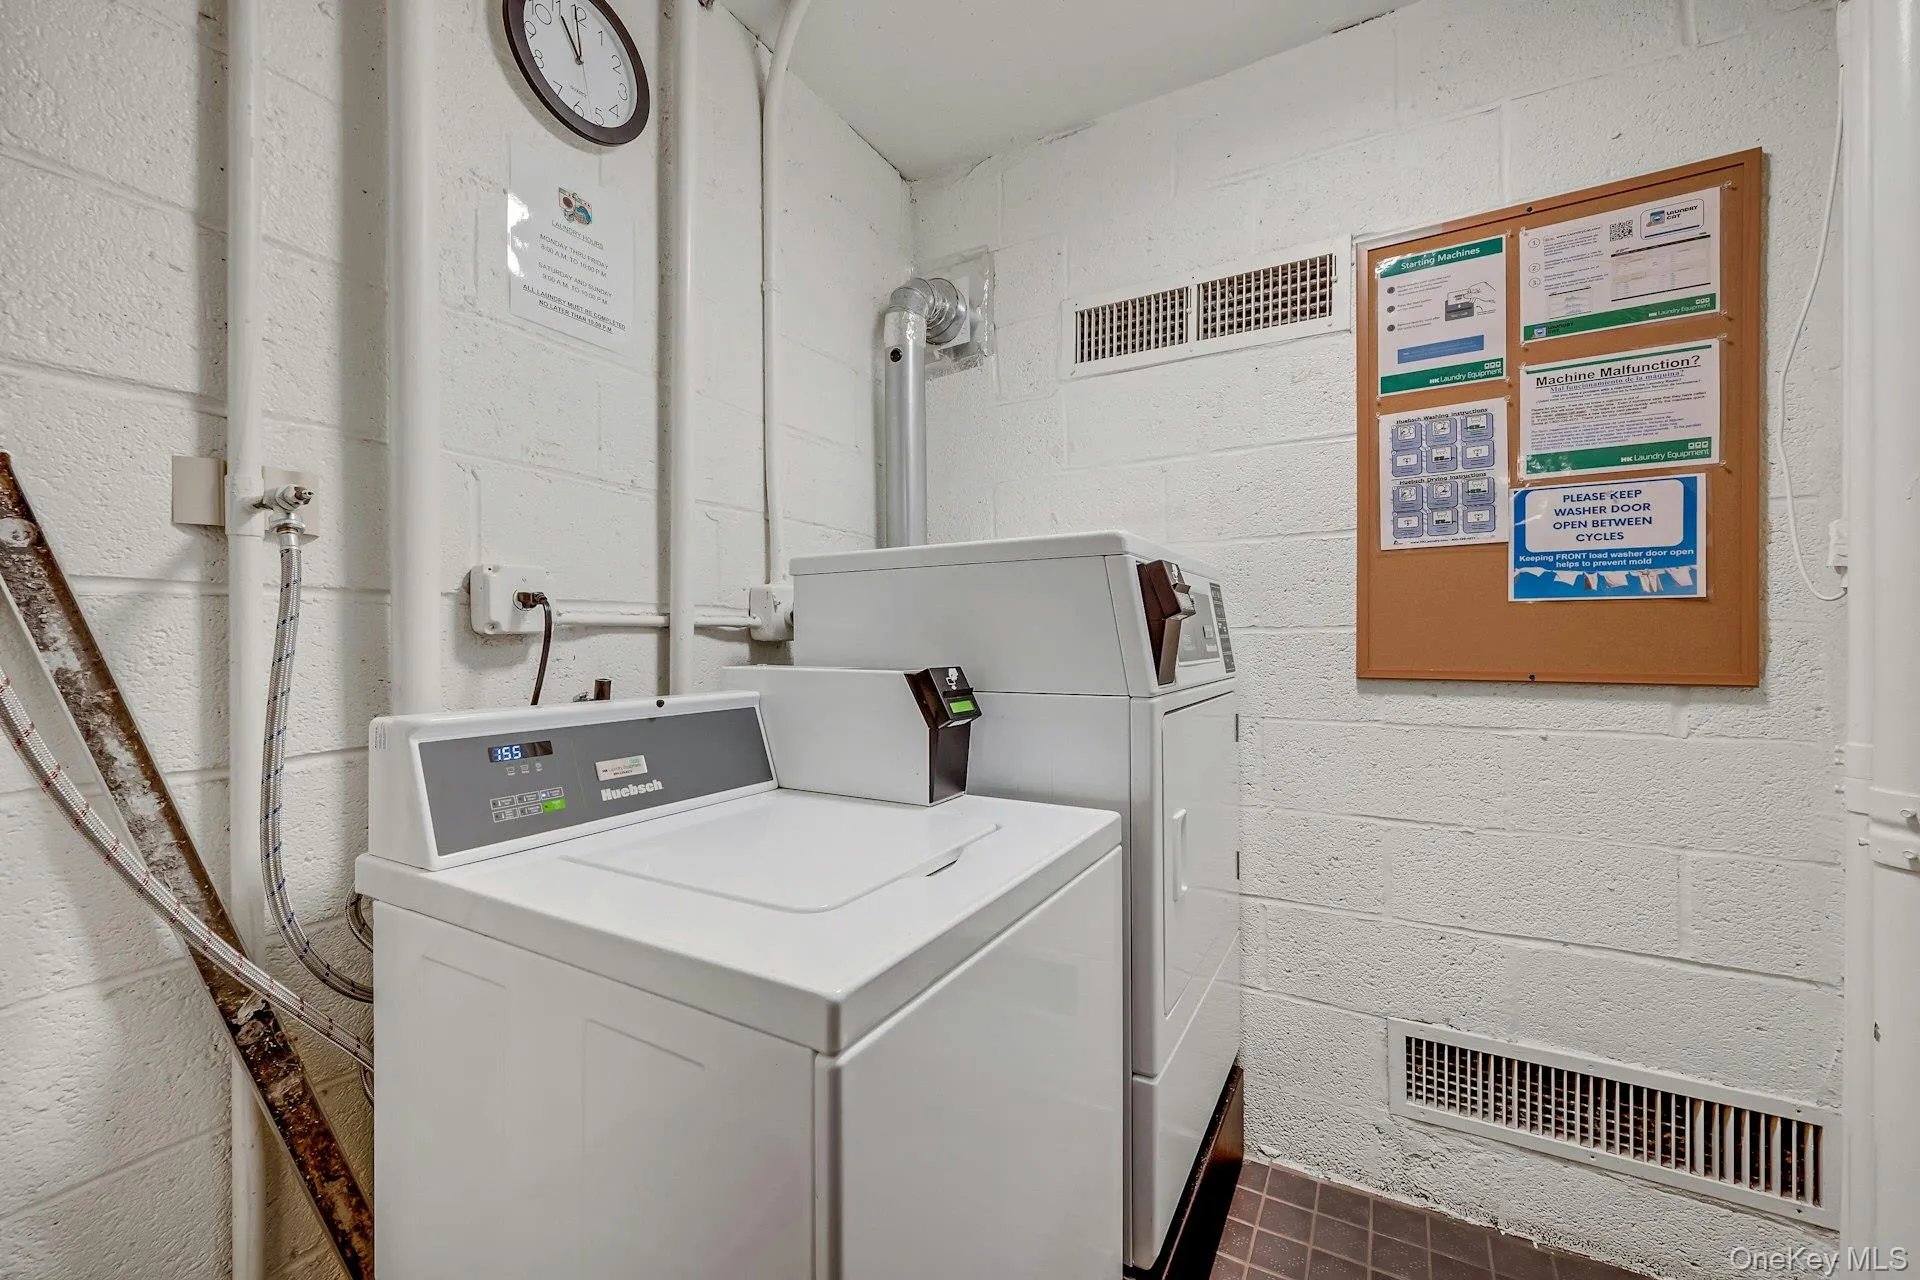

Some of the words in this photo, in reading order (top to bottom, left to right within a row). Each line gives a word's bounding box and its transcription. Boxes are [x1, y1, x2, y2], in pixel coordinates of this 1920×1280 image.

[524, 21, 536, 39] 9
[597, 30, 603, 46] 1
[611, 54, 621, 74] 2
[618, 82, 628, 101] 3
[595, 107, 605, 126] 5
[608, 104, 620, 118] 4
[1666, 205, 1698, 216] LAUNDRY
[552, 219, 582, 240] LAUNDRY
[582, 234, 605, 251] HOURS
[540, 233, 568, 251] MONDAY
[570, 247, 586, 260] THRU
[587, 255, 609, 270] FRIDAY
[1400, 257, 1435, 271] Starting
[1437, 247, 1481, 263] Machines
[570, 256, 579, 265] TO
[538, 261, 573, 281] SATURDAY
[574, 277, 588, 288] AND
[588, 283, 613, 298] SUNDAY
[571, 285, 580, 294] TO
[523, 284, 537, 295] ALL
[536, 289, 566, 306] LAUNDRY
[567, 301, 583, 312] MUST
[584, 307, 593, 317] BE
[593, 312, 626, 331] COMPLETED
[538, 299, 549, 309] NO
[549, 304, 570, 316] LATER
[570, 311, 587, 323] THAN
[1658, 307, 1681, 316] Laundry
[1681, 302, 1711, 312] Equipment
[1440, 372, 1467, 384] Laundry
[1467, 367, 1503, 379] Equipment
[1536, 371, 1596, 387] Machine
[1600, 354, 1701, 378] Malfunction?
[1565, 376, 1624, 391] funcionamiento
[1423, 412, 1449, 421] Washing
[1451, 407, 1489, 418] Instructions
[1634, 451, 1665, 463] Laundry
[1667, 448, 1710, 460] Equipment
[1427, 475, 1448, 484] Drying
[1450, 471, 1487, 480] Instructions
[1562, 492, 1606, 503] PLEASE
[1610, 489, 1643, 501] KEEP
[1554, 505, 1607, 517] WASHER
[1611, 502, 1651, 513] DOOR
[1553, 520, 1588, 530] OPEN
[1591, 516, 1653, 528] BETWEEN
[1575, 532, 1625, 542] CYCLES
[1519, 554, 1554, 563] Keeping
[1555, 552, 1588, 561] FRONT
[1588, 551, 1608, 559] load
[1610, 550, 1645, 558] washer
[1646, 549, 1669, 557] door
[1669, 549, 1694, 557] open
[1556, 559, 1580, 568] helps
[1592, 558, 1628, 567] prevent
[1628, 557, 1652, 566] mold
[600, 779, 663, 801] Huebsch
